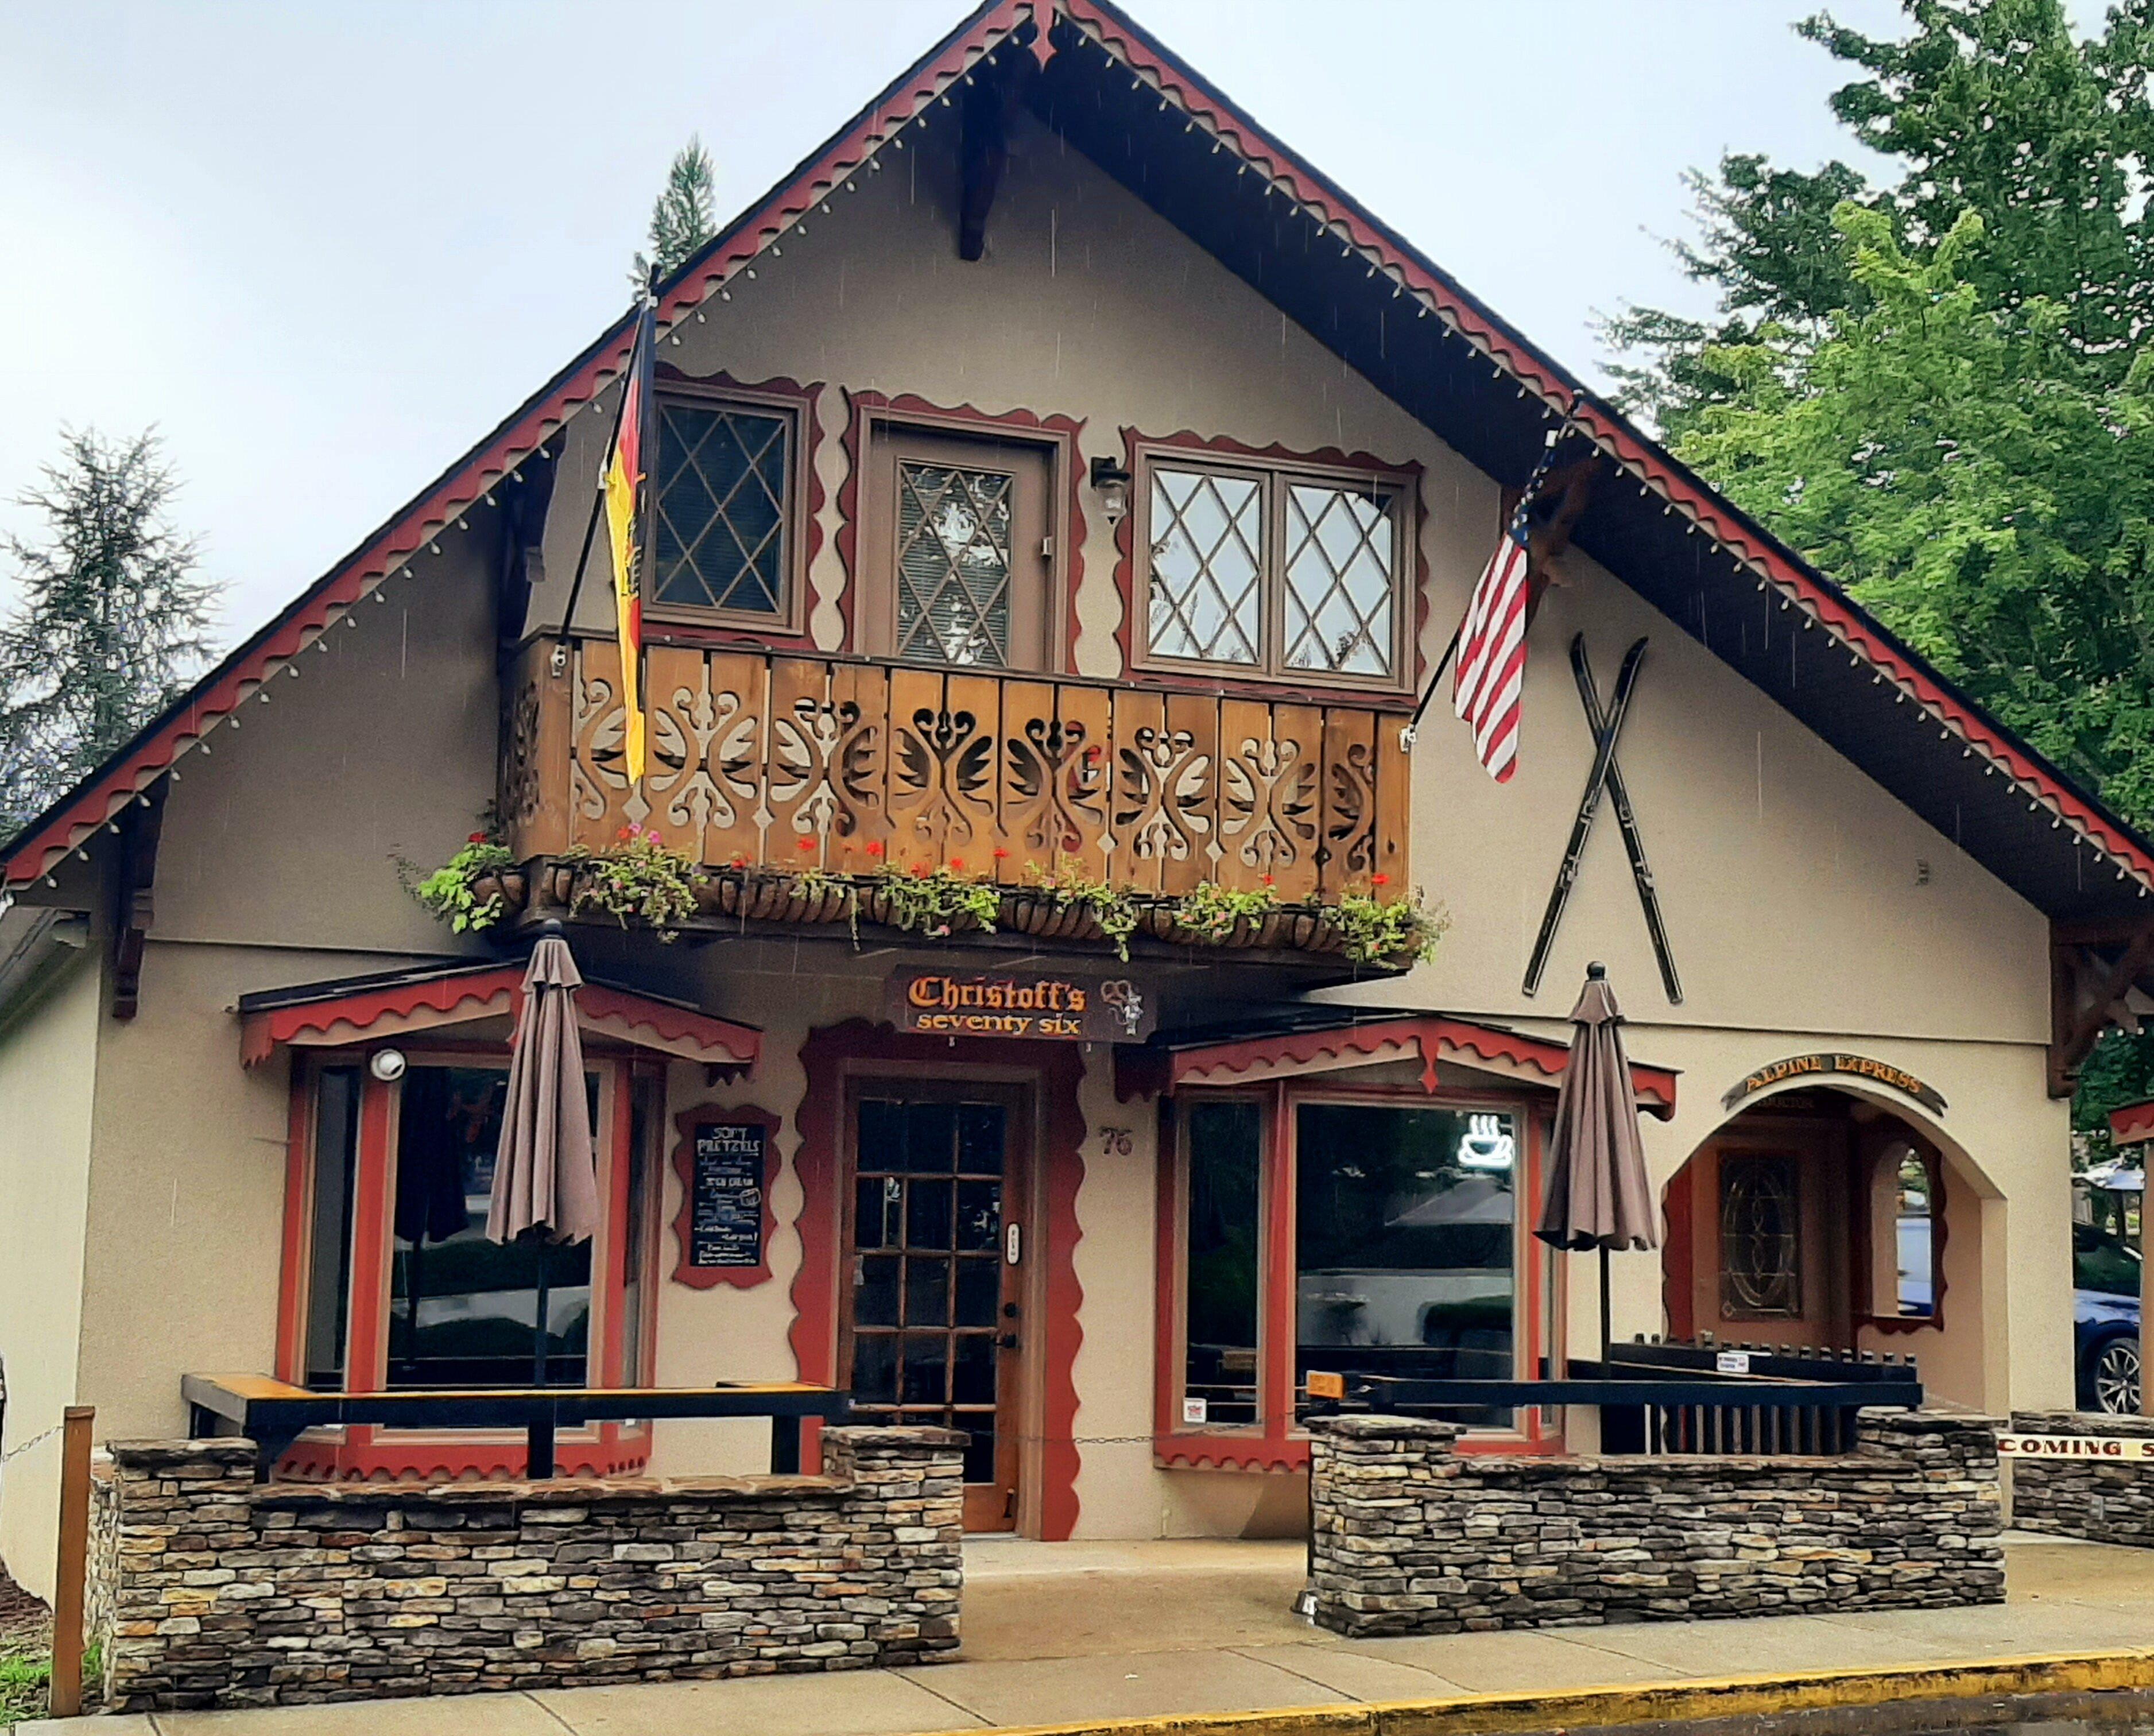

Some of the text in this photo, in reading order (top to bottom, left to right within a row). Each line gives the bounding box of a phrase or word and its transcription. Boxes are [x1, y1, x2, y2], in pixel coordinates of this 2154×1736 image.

[909, 975, 1086, 1012] Christoff's
[916, 1013, 1082, 1035] seventy six
[1746, 1055, 1923, 1094] ALPINE EXPRESS
[711, 1126, 748, 1140] SOFT
[1099, 1126, 1133, 1156] 76
[696, 1139, 762, 1153] PRETZELS
[1998, 1439, 2122, 1456] COMING
